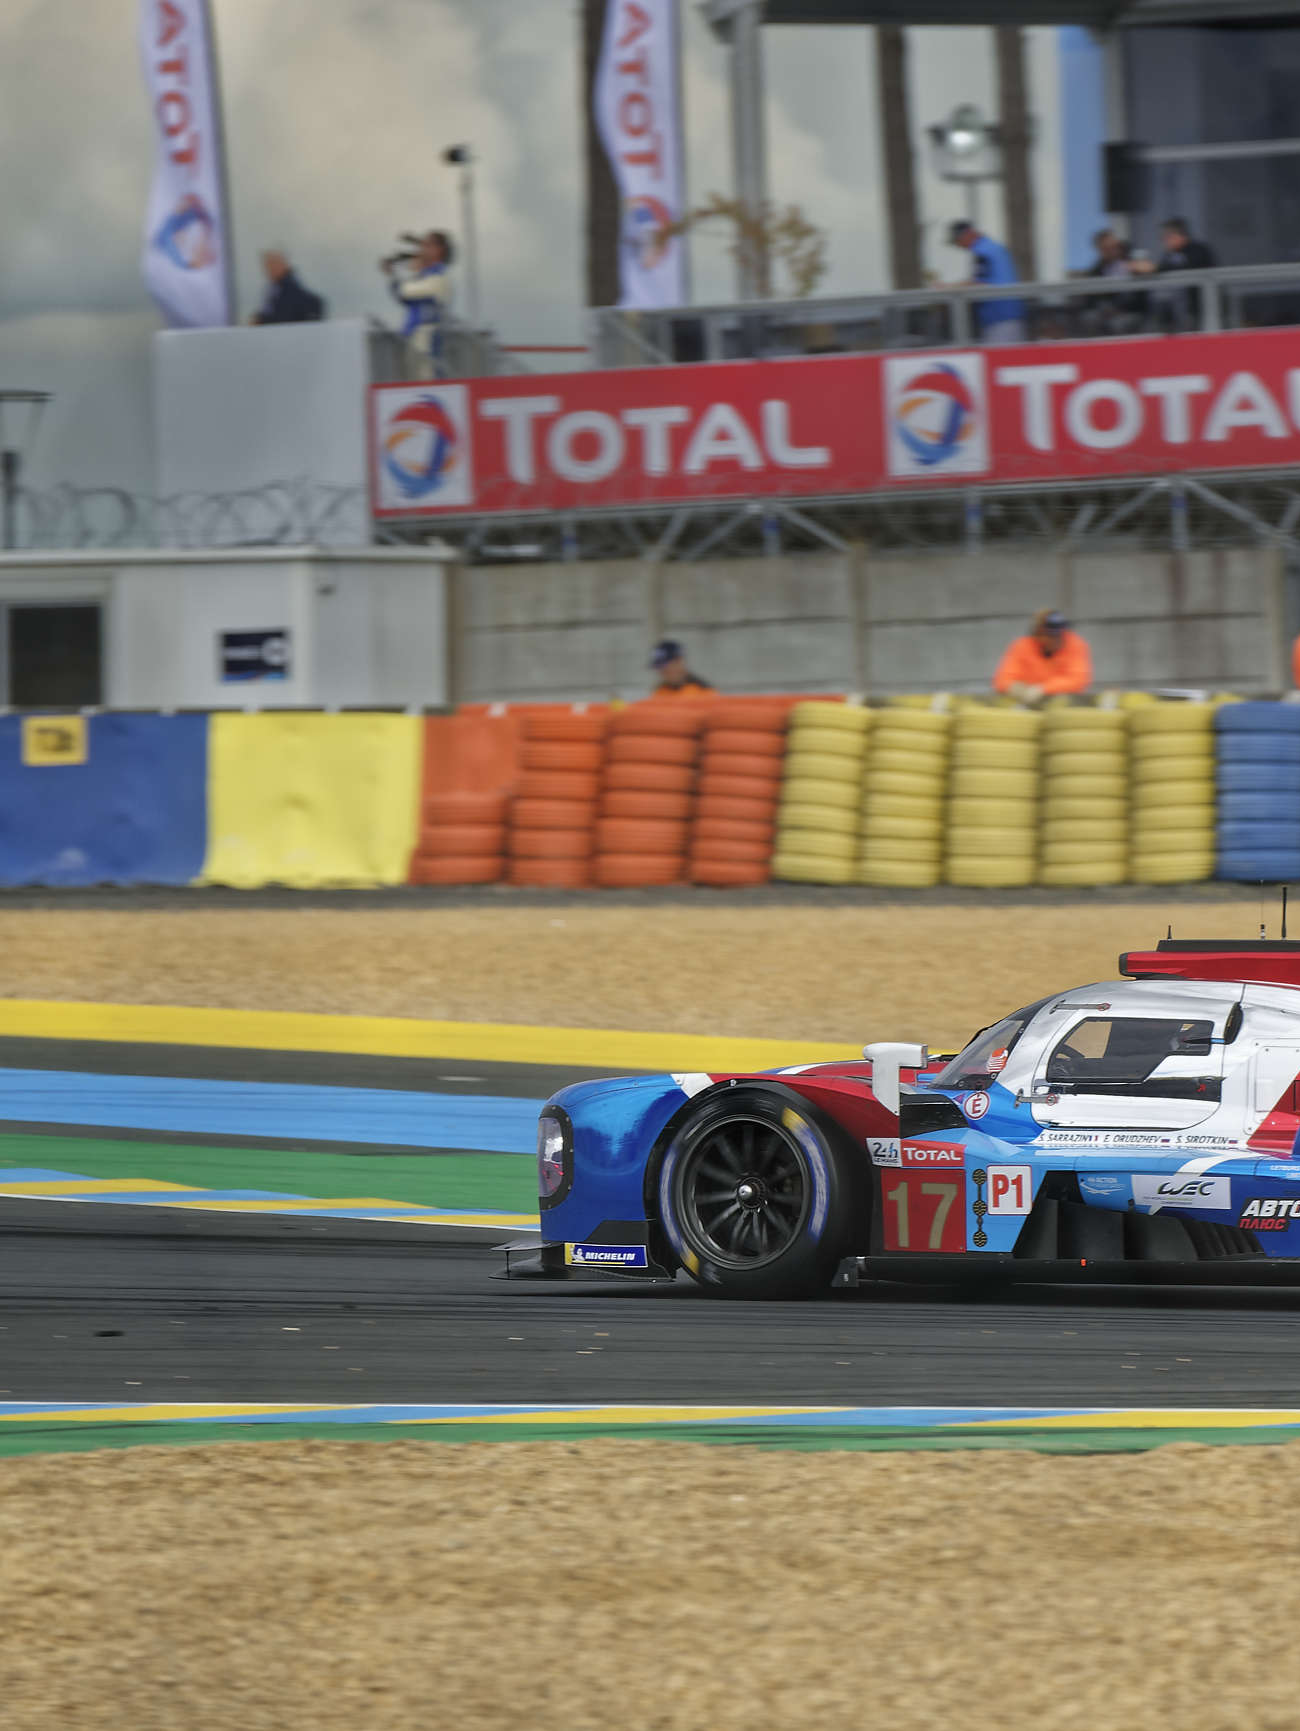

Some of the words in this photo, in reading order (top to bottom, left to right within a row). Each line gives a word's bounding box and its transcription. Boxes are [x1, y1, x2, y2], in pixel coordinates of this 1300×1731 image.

[477, 395, 831, 484] TOTAL
[1047, 1134, 1088, 1142] SARRAZIN
[1113, 1134, 1161, 1143] ORUDZHEV
[1186, 1135, 1229, 1145] SIROTKIN
[904, 1147, 961, 1161] TOTAL
[991, 1174, 1023, 1208] P1
[1157, 1180, 1216, 1196] WEC
[887, 1181, 959, 1249] 17
[1239, 1218, 1287, 1231] ПЛЮС
[585, 1251, 636, 1261] MICHELIN
